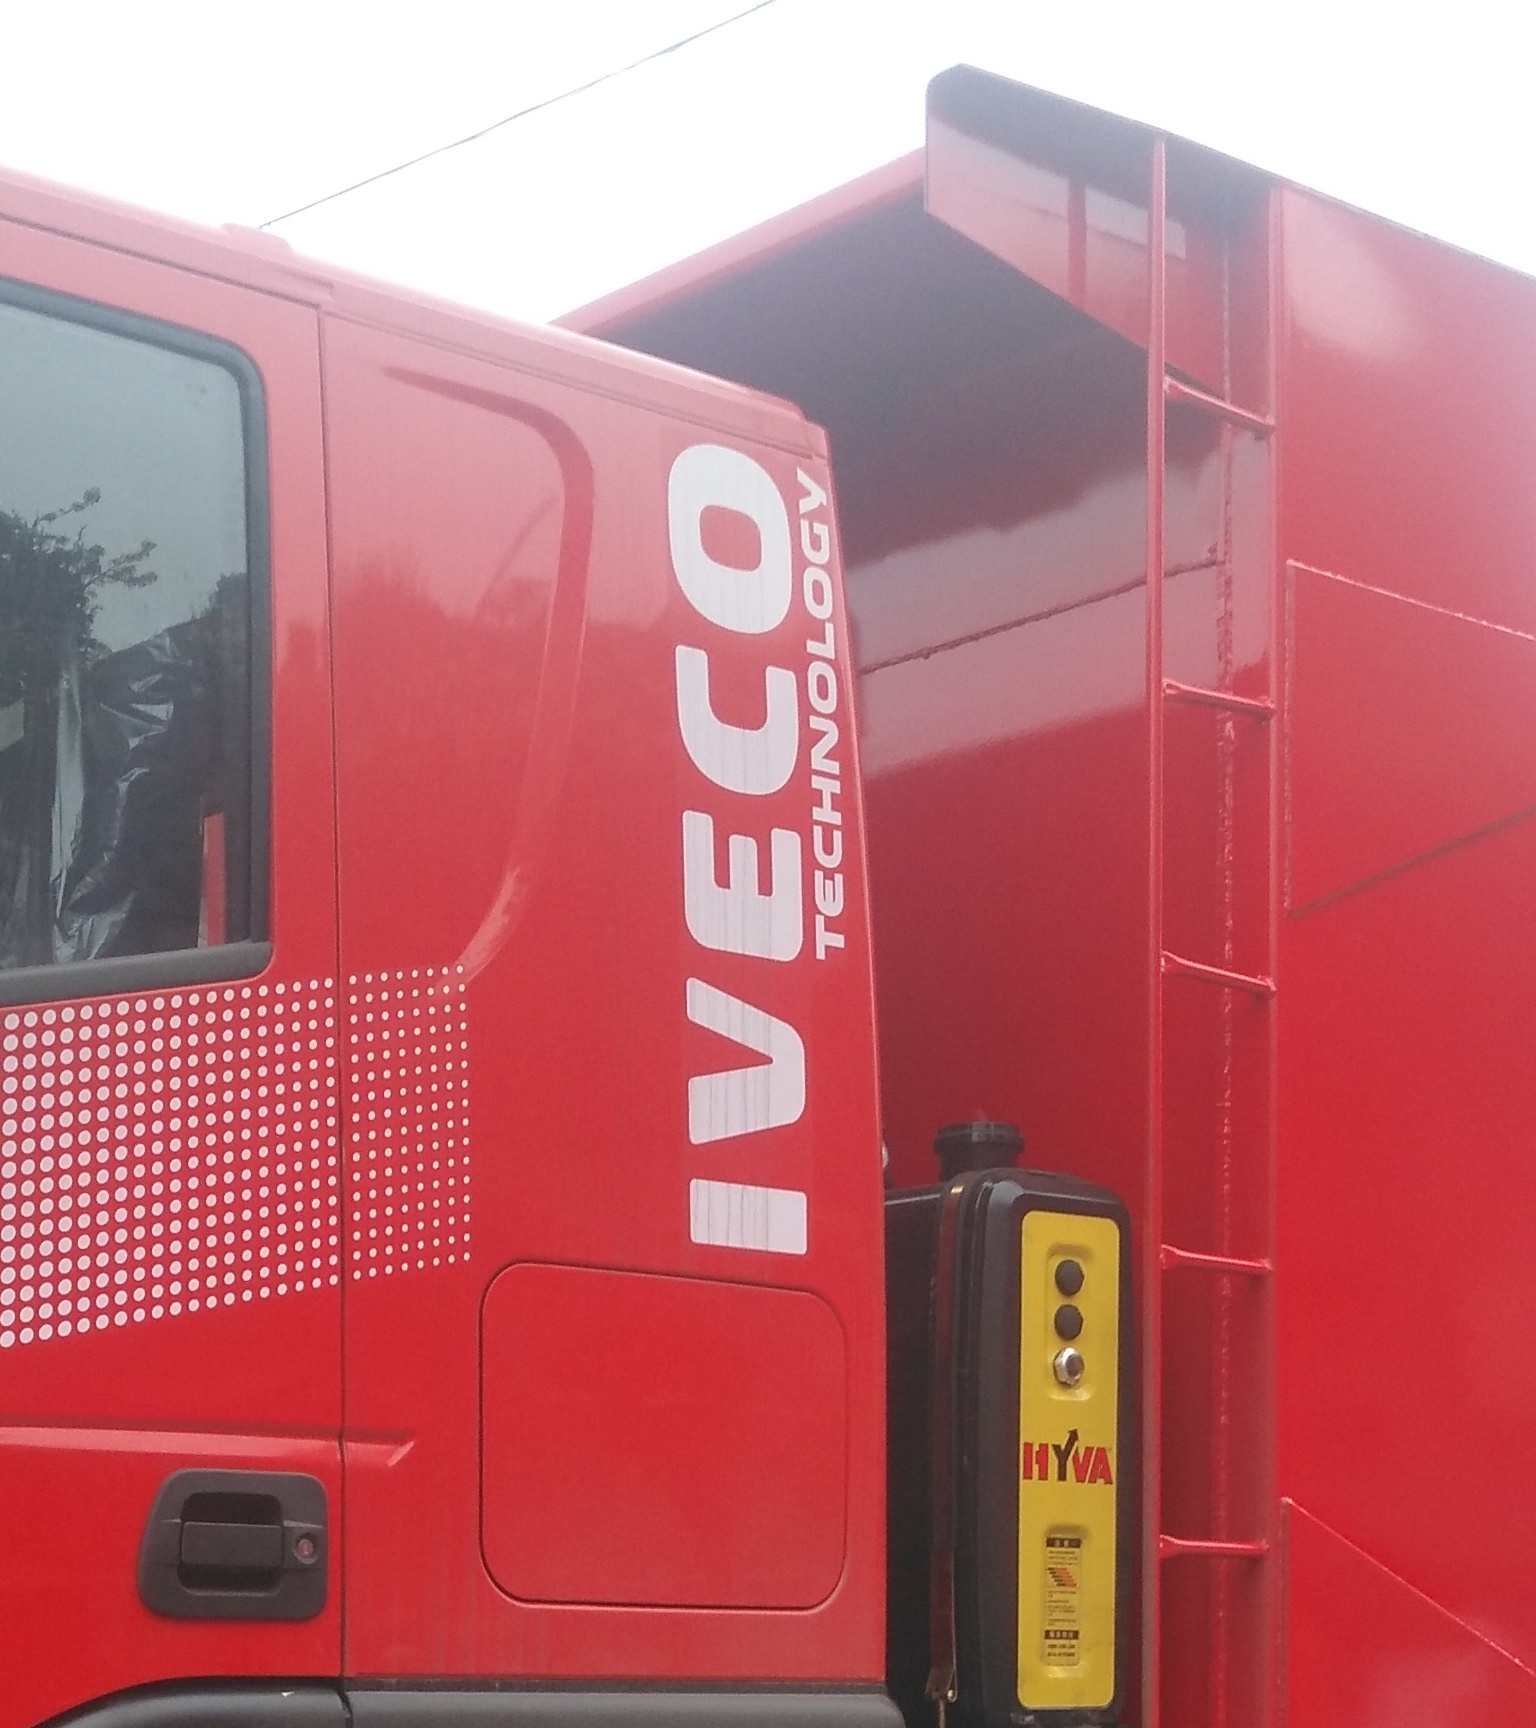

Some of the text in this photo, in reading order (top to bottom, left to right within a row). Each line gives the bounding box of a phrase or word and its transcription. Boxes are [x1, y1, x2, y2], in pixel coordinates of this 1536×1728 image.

[668, 443, 809, 1256] IVECO
[795, 467, 846, 961] TECHNOLOGY
[1022, 1427, 1113, 1485] HYVA
